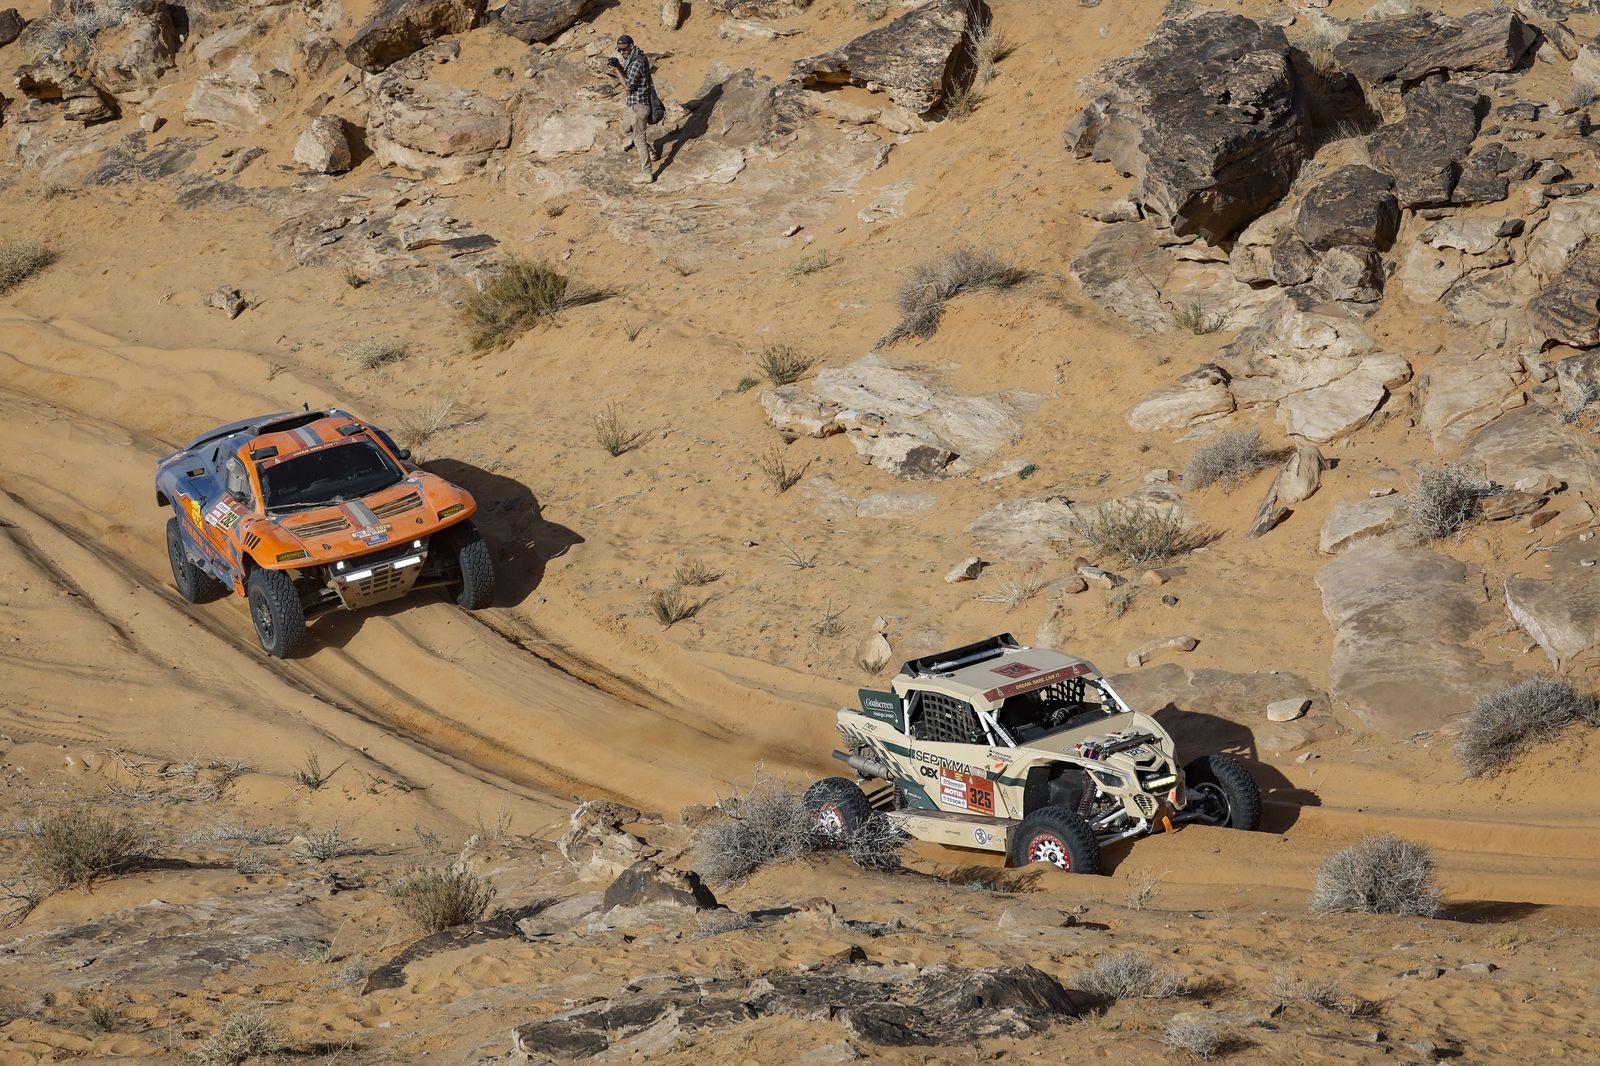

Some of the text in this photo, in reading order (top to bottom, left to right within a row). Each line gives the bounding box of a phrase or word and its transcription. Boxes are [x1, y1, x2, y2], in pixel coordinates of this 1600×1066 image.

[915, 750, 972, 776] SEPTYMA
[943, 787, 964, 798] MOTUL
[969, 787, 991, 809] 325
